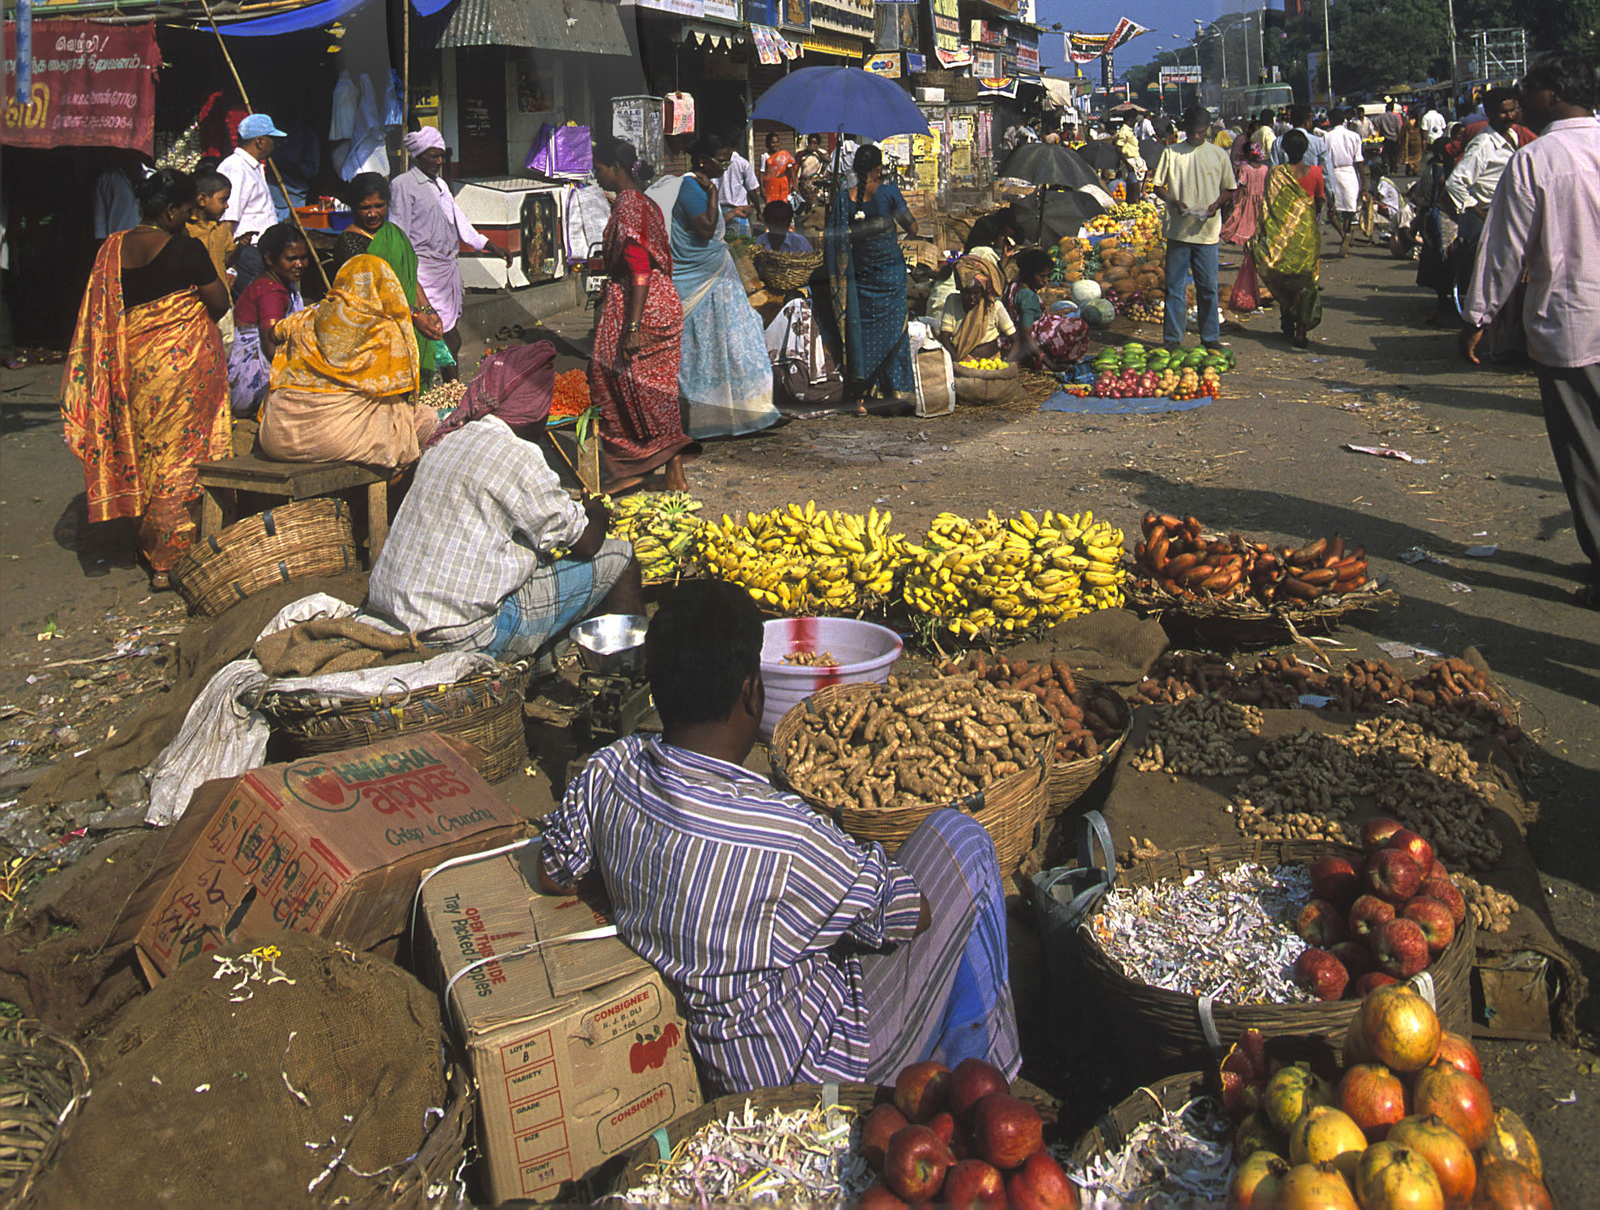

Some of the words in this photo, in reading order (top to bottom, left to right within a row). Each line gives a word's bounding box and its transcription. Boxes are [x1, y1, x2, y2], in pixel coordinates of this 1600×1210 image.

[361, 769, 471, 819] apples
[443, 893, 461, 914] Tray
[464, 907, 487, 934] OPEN
[451, 918, 478, 958] Packed
[475, 934, 495, 961] THIS
[465, 955, 493, 998] Apples
[485, 959, 507, 986] SIDE
[593, 991, 650, 1023] CONSIGNEE
[612, 1027, 619, 1036] B
[509, 1044, 524, 1055] LOT
[524, 1040, 537, 1049] NO.
[512, 1069, 543, 1085] VARIETY
[516, 1101, 541, 1115] GRADE
[523, 1132, 540, 1143] SIZE
[525, 1161, 551, 1176] COUNT
